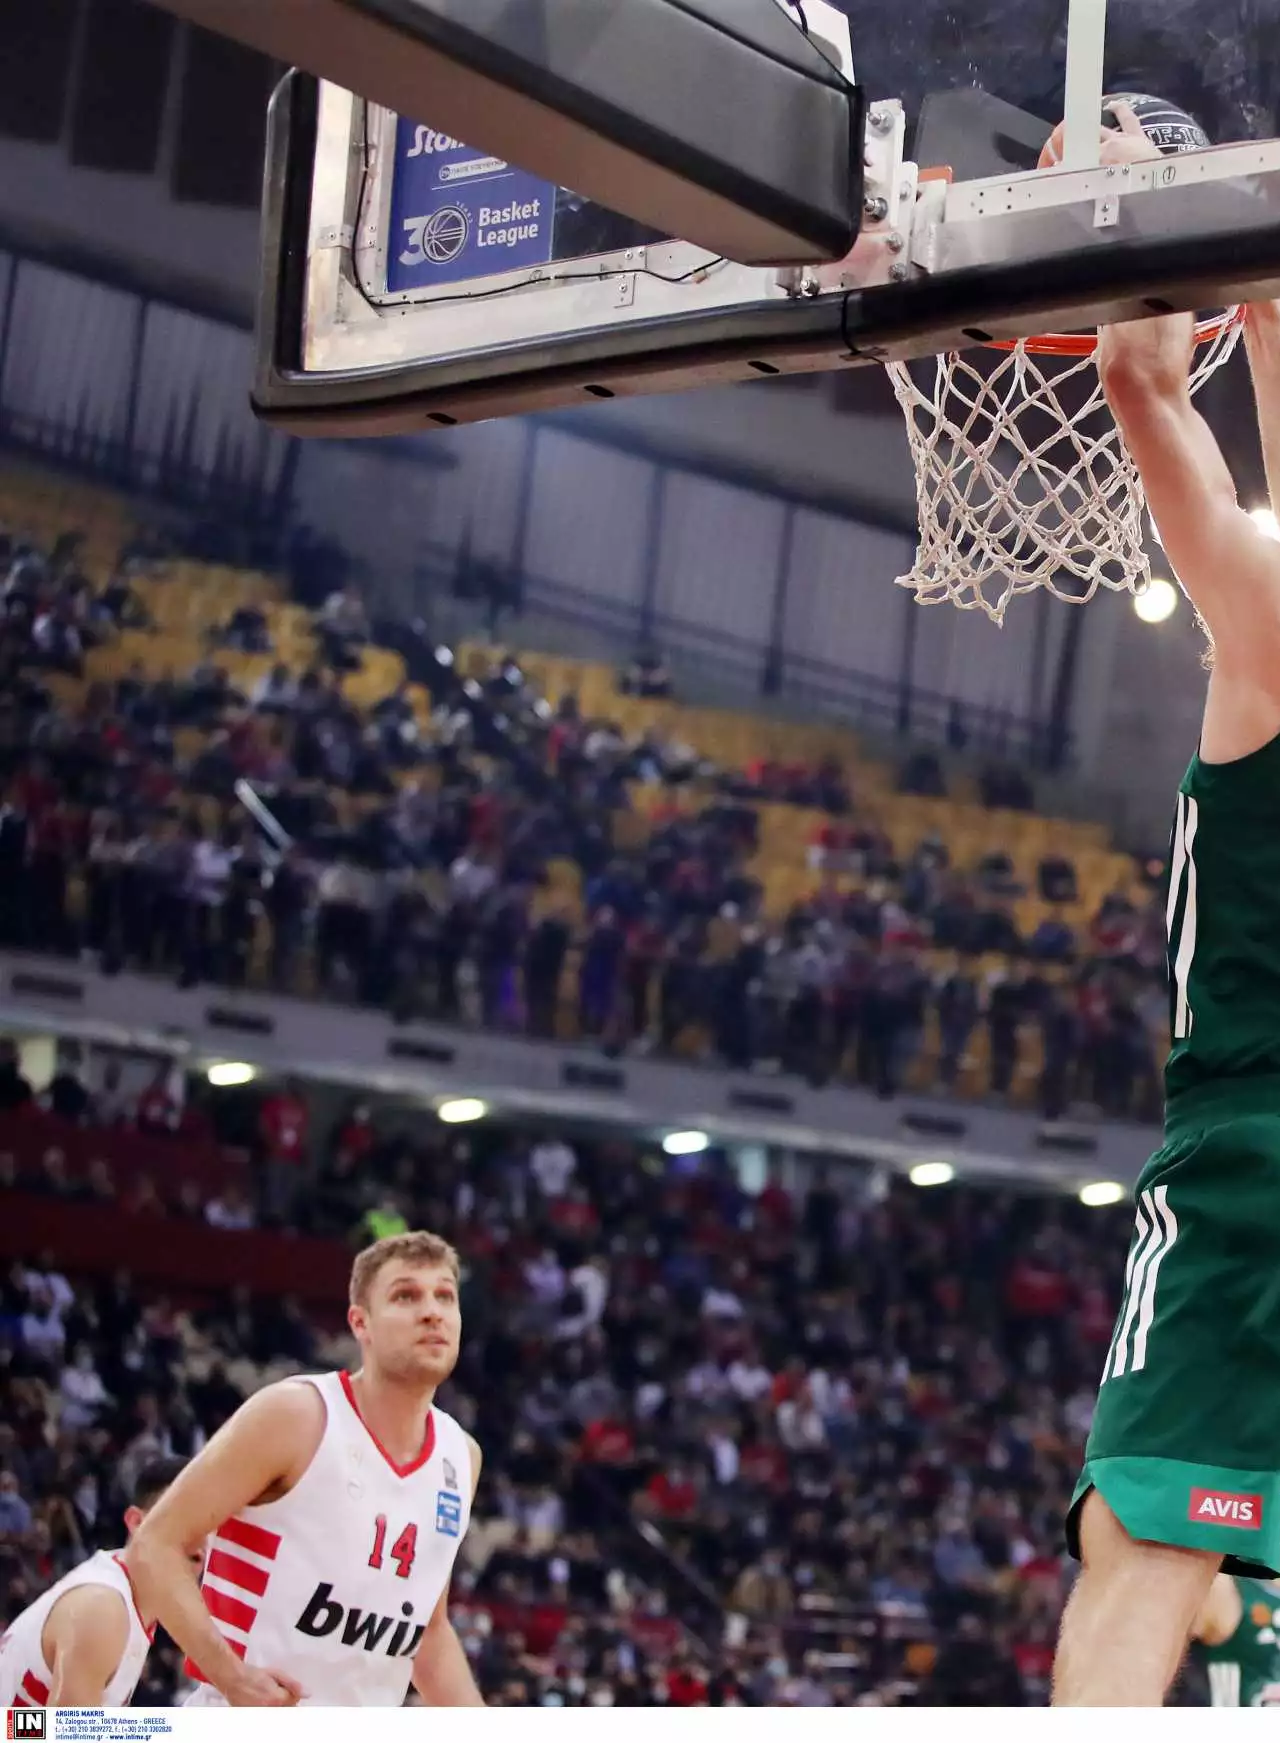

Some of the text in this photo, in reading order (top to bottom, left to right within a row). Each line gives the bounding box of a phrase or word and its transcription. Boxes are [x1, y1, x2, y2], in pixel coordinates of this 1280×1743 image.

[478, 199, 540, 227] Basket
[477, 223, 539, 248] League
[1197, 1497, 1254, 1521] AVIS
[368, 1513, 418, 1579] 14
